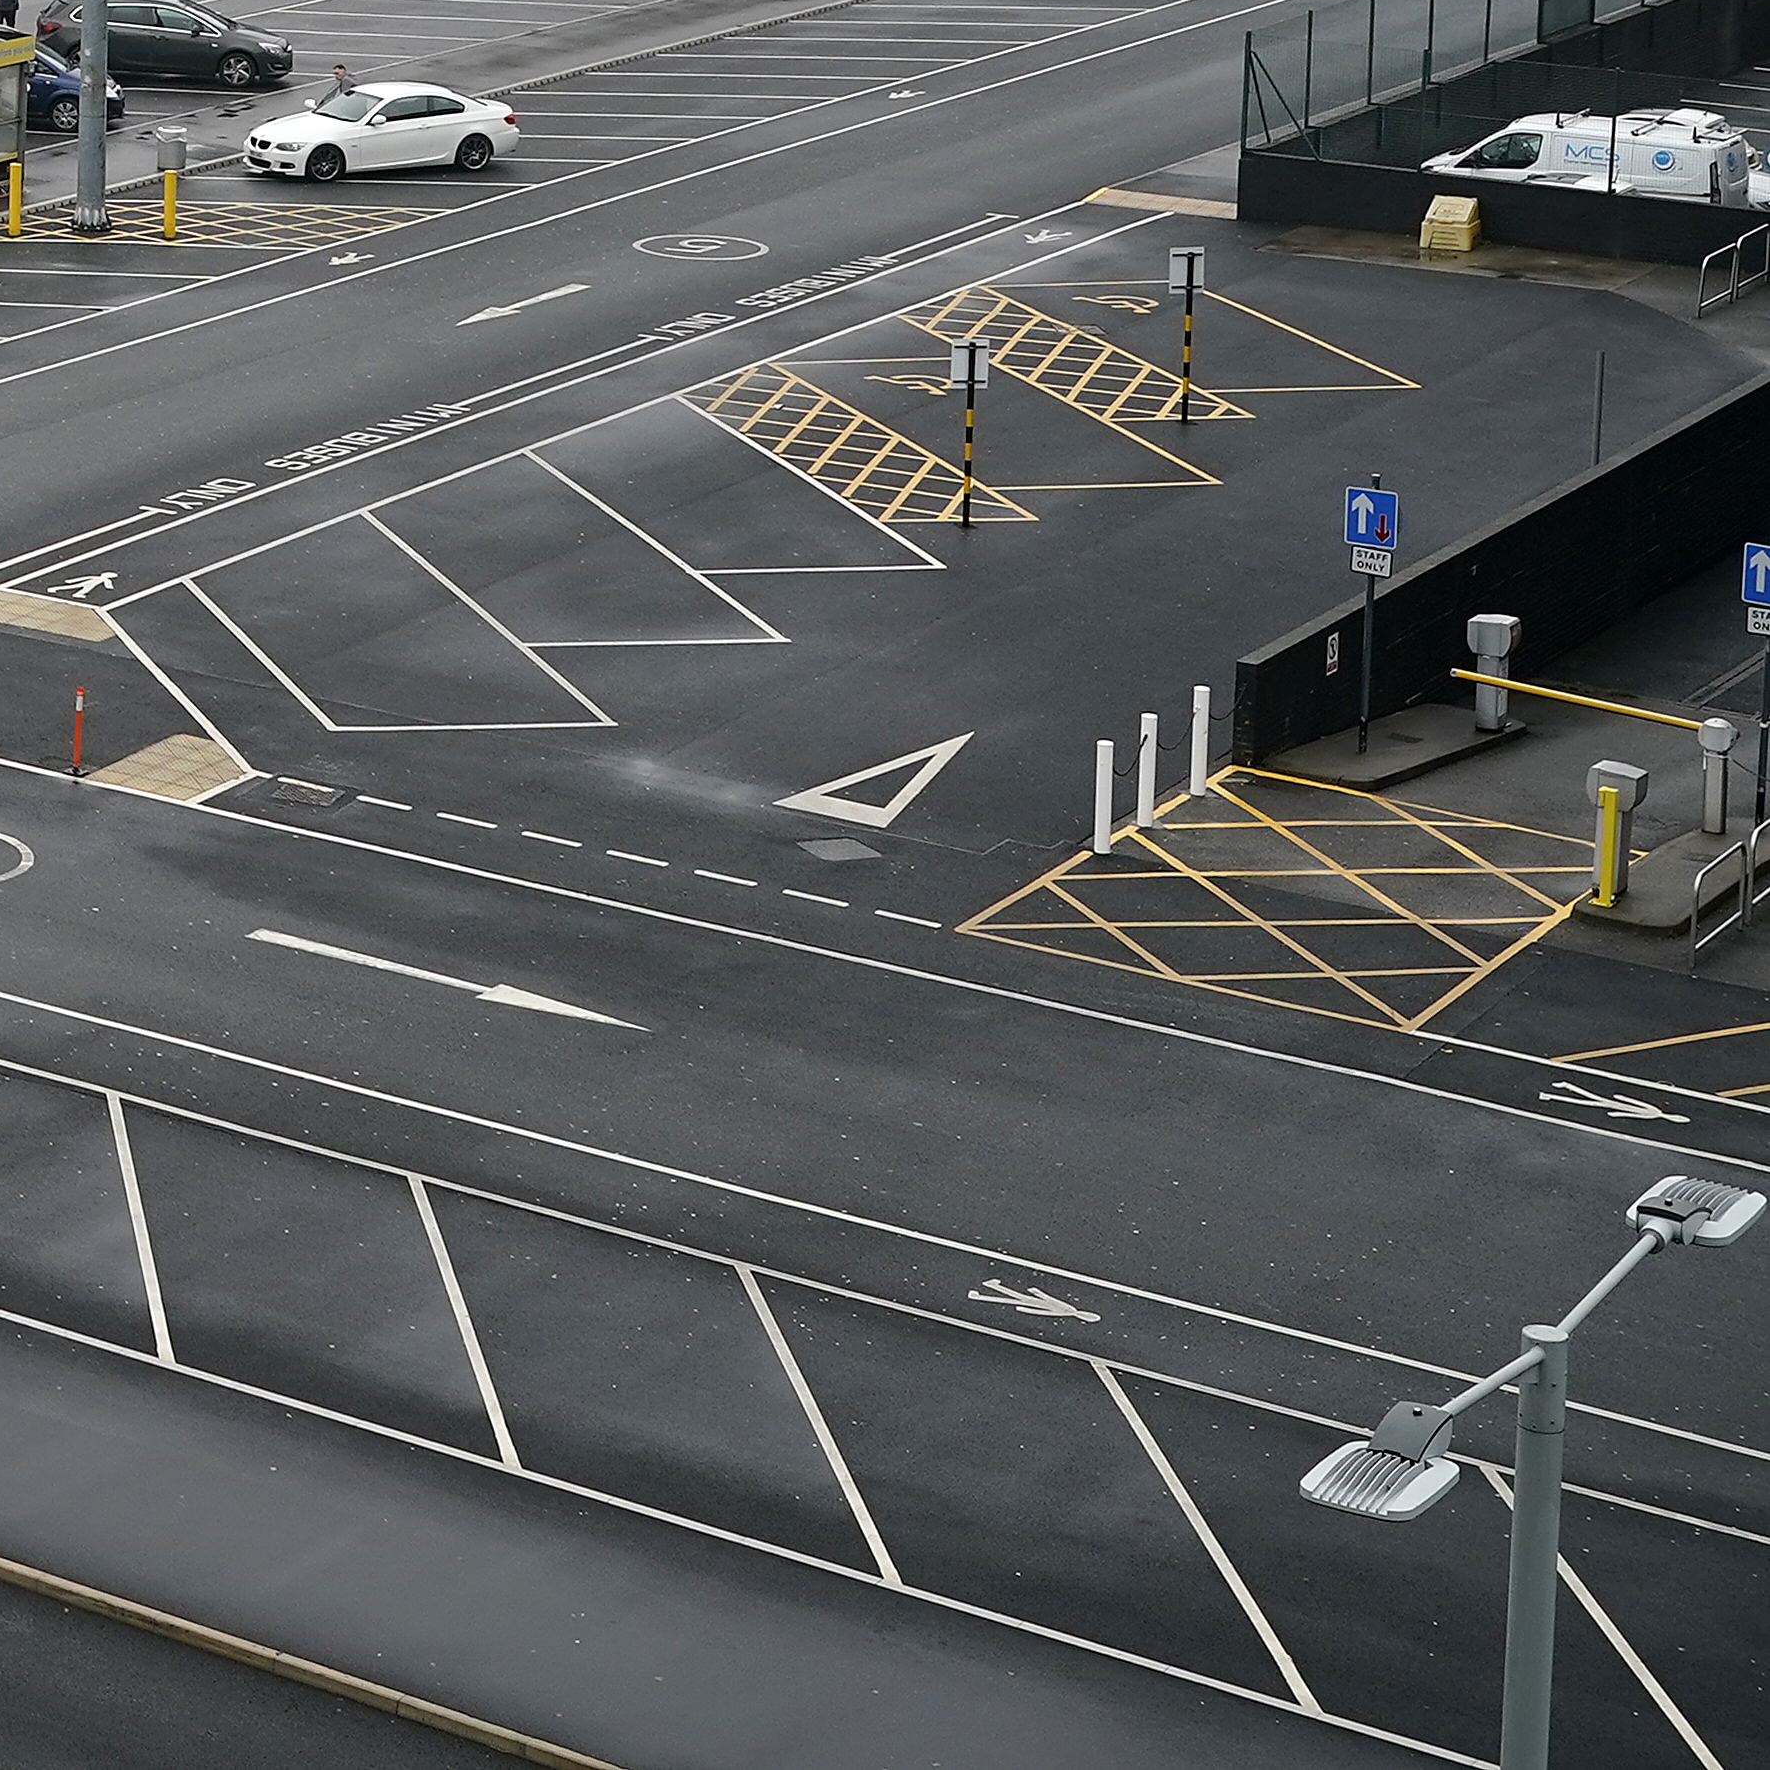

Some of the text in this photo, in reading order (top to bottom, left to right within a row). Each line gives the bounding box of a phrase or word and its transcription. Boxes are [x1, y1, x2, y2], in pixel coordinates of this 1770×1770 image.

[160, 478, 256, 510] ONLY
[1356, 551, 1389, 562] STAFF
[1356, 561, 1386, 573] ONLY
[1752, 609, 1770, 619] STA
[1753, 621, 1770, 631] ON
